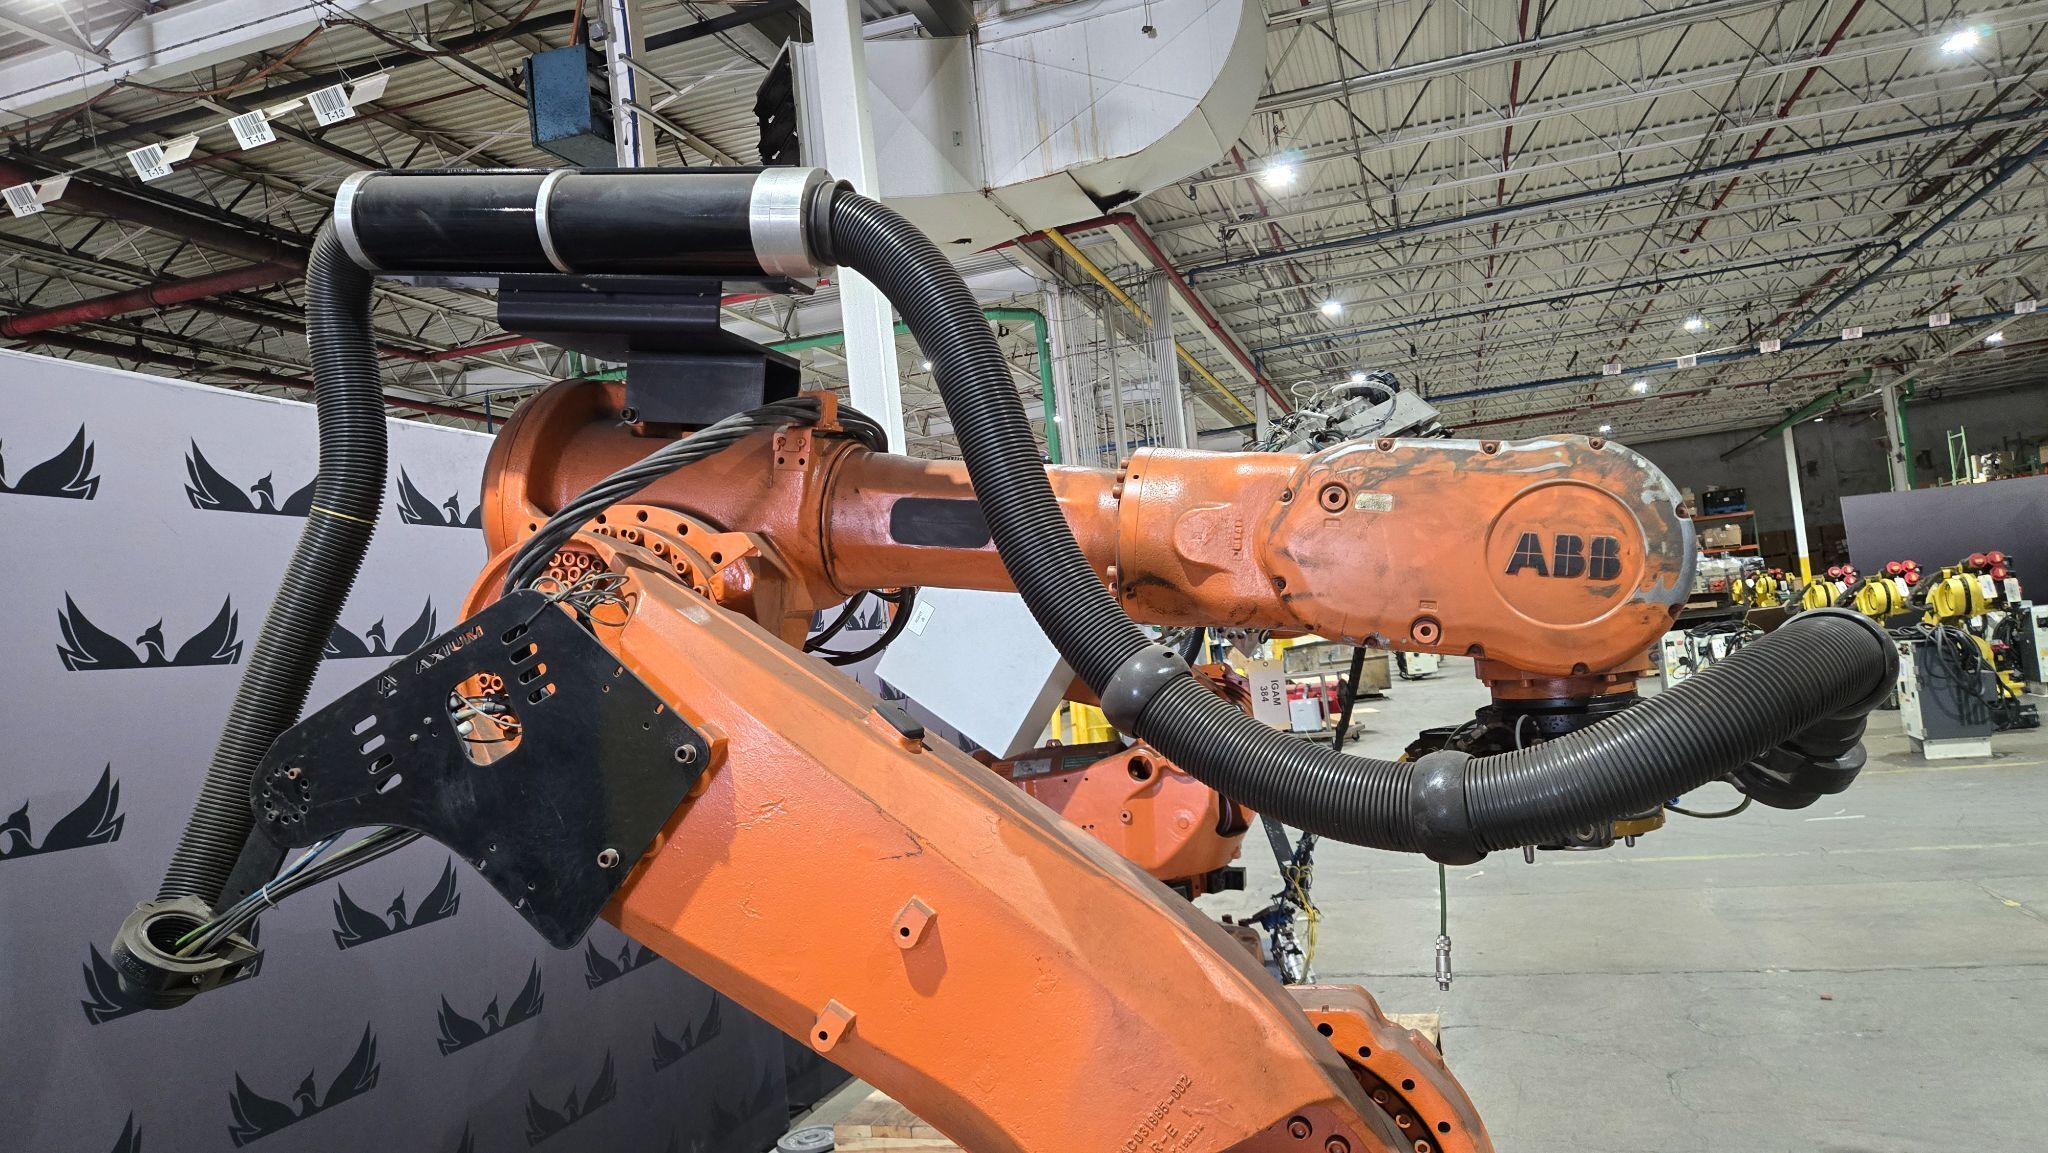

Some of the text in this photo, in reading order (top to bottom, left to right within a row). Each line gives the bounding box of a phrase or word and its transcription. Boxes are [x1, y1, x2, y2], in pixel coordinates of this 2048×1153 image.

[324, 108, 346, 122] T-13
[246, 133, 267, 145] T-14
[145, 166, 165, 178] T-15
[19, 204, 37, 215] T-16
[1504, 531, 1623, 581] ABB
[415, 624, 485, 675] AXIUM
[1260, 685, 1270, 703] 384
[1271, 679, 1282, 706] IGAM
